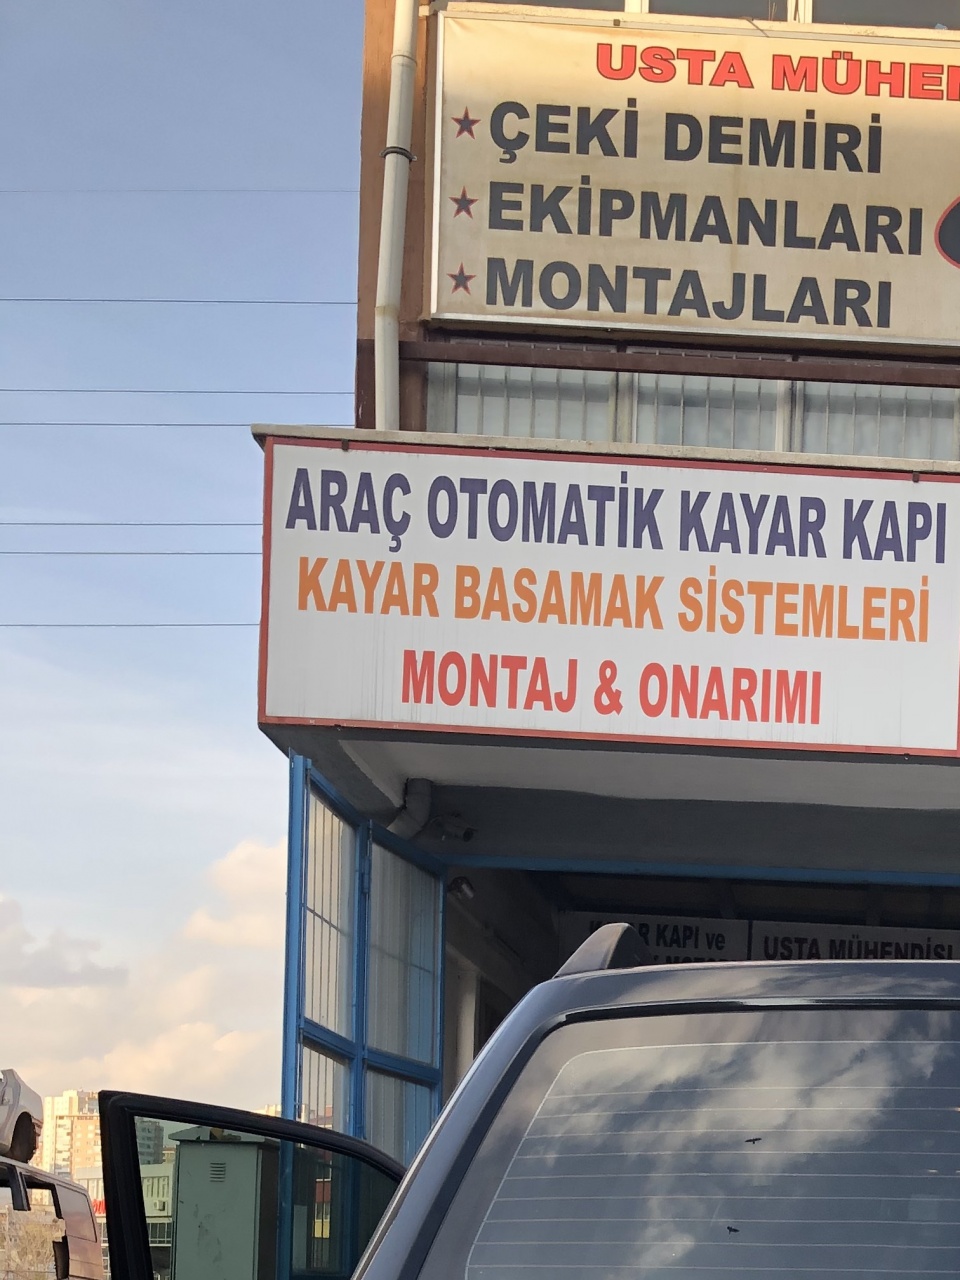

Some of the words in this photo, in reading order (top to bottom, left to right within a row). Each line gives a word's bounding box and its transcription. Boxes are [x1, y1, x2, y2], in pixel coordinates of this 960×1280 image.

[596, 43, 754, 88] USTA
[490, 98, 638, 163] ÇEKİ
[664, 109, 882, 173] DEMİRİ
[488, 175, 923, 256] EKİPMANLARI
[485, 257, 891, 328] MONTAJLARI
[285, 467, 411, 553] ARAÇ
[427, 470, 664, 550] OTOMATİK
[679, 489, 827, 559] KAYAR
[843, 498, 947, 564] KAPI
[297, 556, 440, 618] KAYAR
[454, 564, 664, 630] BASAMAK
[677, 564, 929, 643] SİSTEMLERİ
[401, 649, 577, 713] MONTAJ
[594, 660, 623, 715] &
[639, 663, 822, 725] ONARIMI
[656, 923, 700, 949] KAPI
[706, 932, 726, 951] ve
[764, 935, 821, 960] USTA
